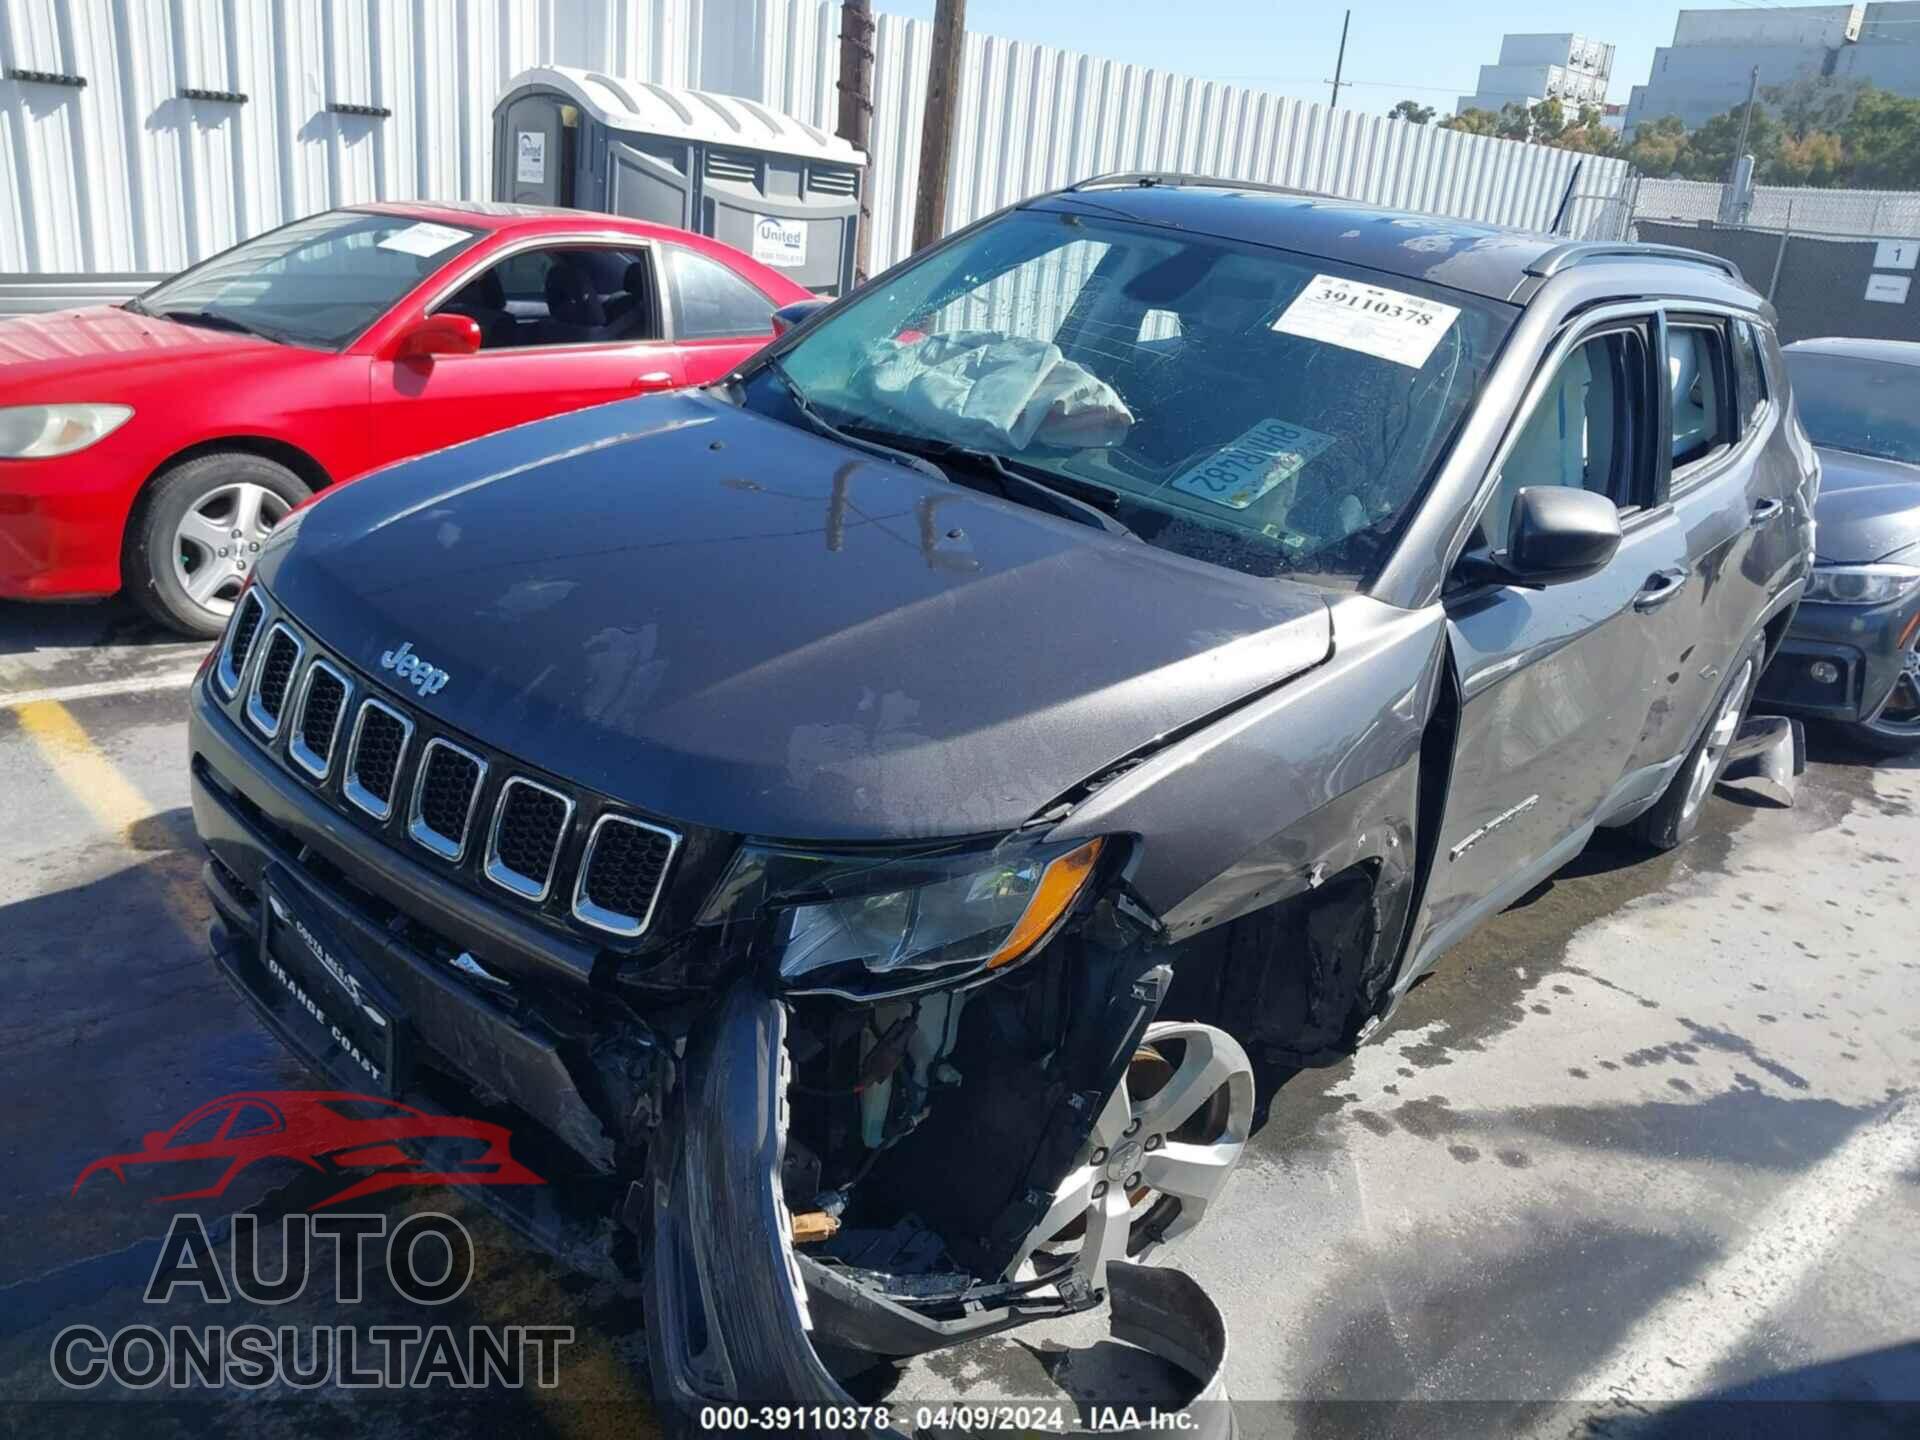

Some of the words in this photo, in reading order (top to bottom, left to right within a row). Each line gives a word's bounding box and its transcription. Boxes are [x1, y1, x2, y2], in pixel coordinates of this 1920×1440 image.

[761, 226, 801, 243] United
[1895, 248, 1902, 262] 1
[1316, 289, 1433, 326] 39110378
[381, 642, 450, 697] Jeep
[269, 959, 326, 1024] ORANGE
[331, 1025, 381, 1080] COAST
